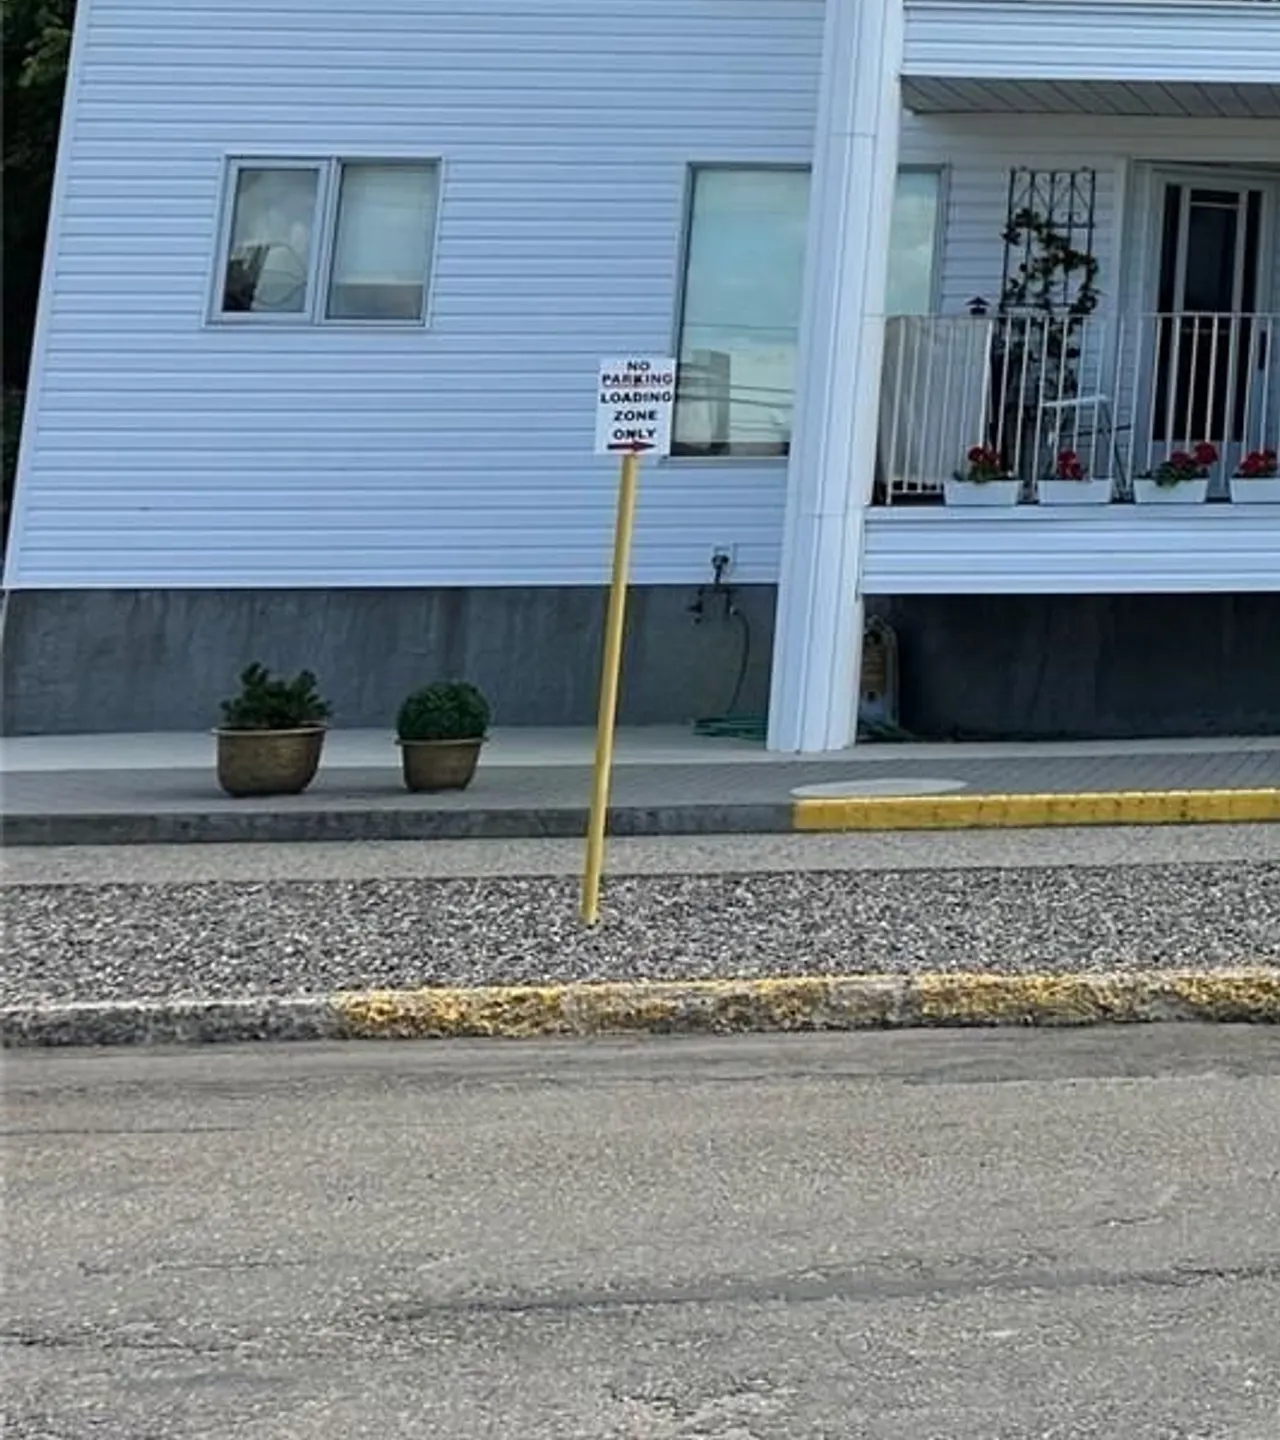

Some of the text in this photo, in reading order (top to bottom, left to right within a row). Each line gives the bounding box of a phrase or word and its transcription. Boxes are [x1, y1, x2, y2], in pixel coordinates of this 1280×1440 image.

[626, 361, 650, 371] NO
[601, 374, 673, 384] PARKING
[600, 391, 671, 403] LOADING
[614, 410, 657, 421] ZONE
[613, 428, 656, 440] ONLY
